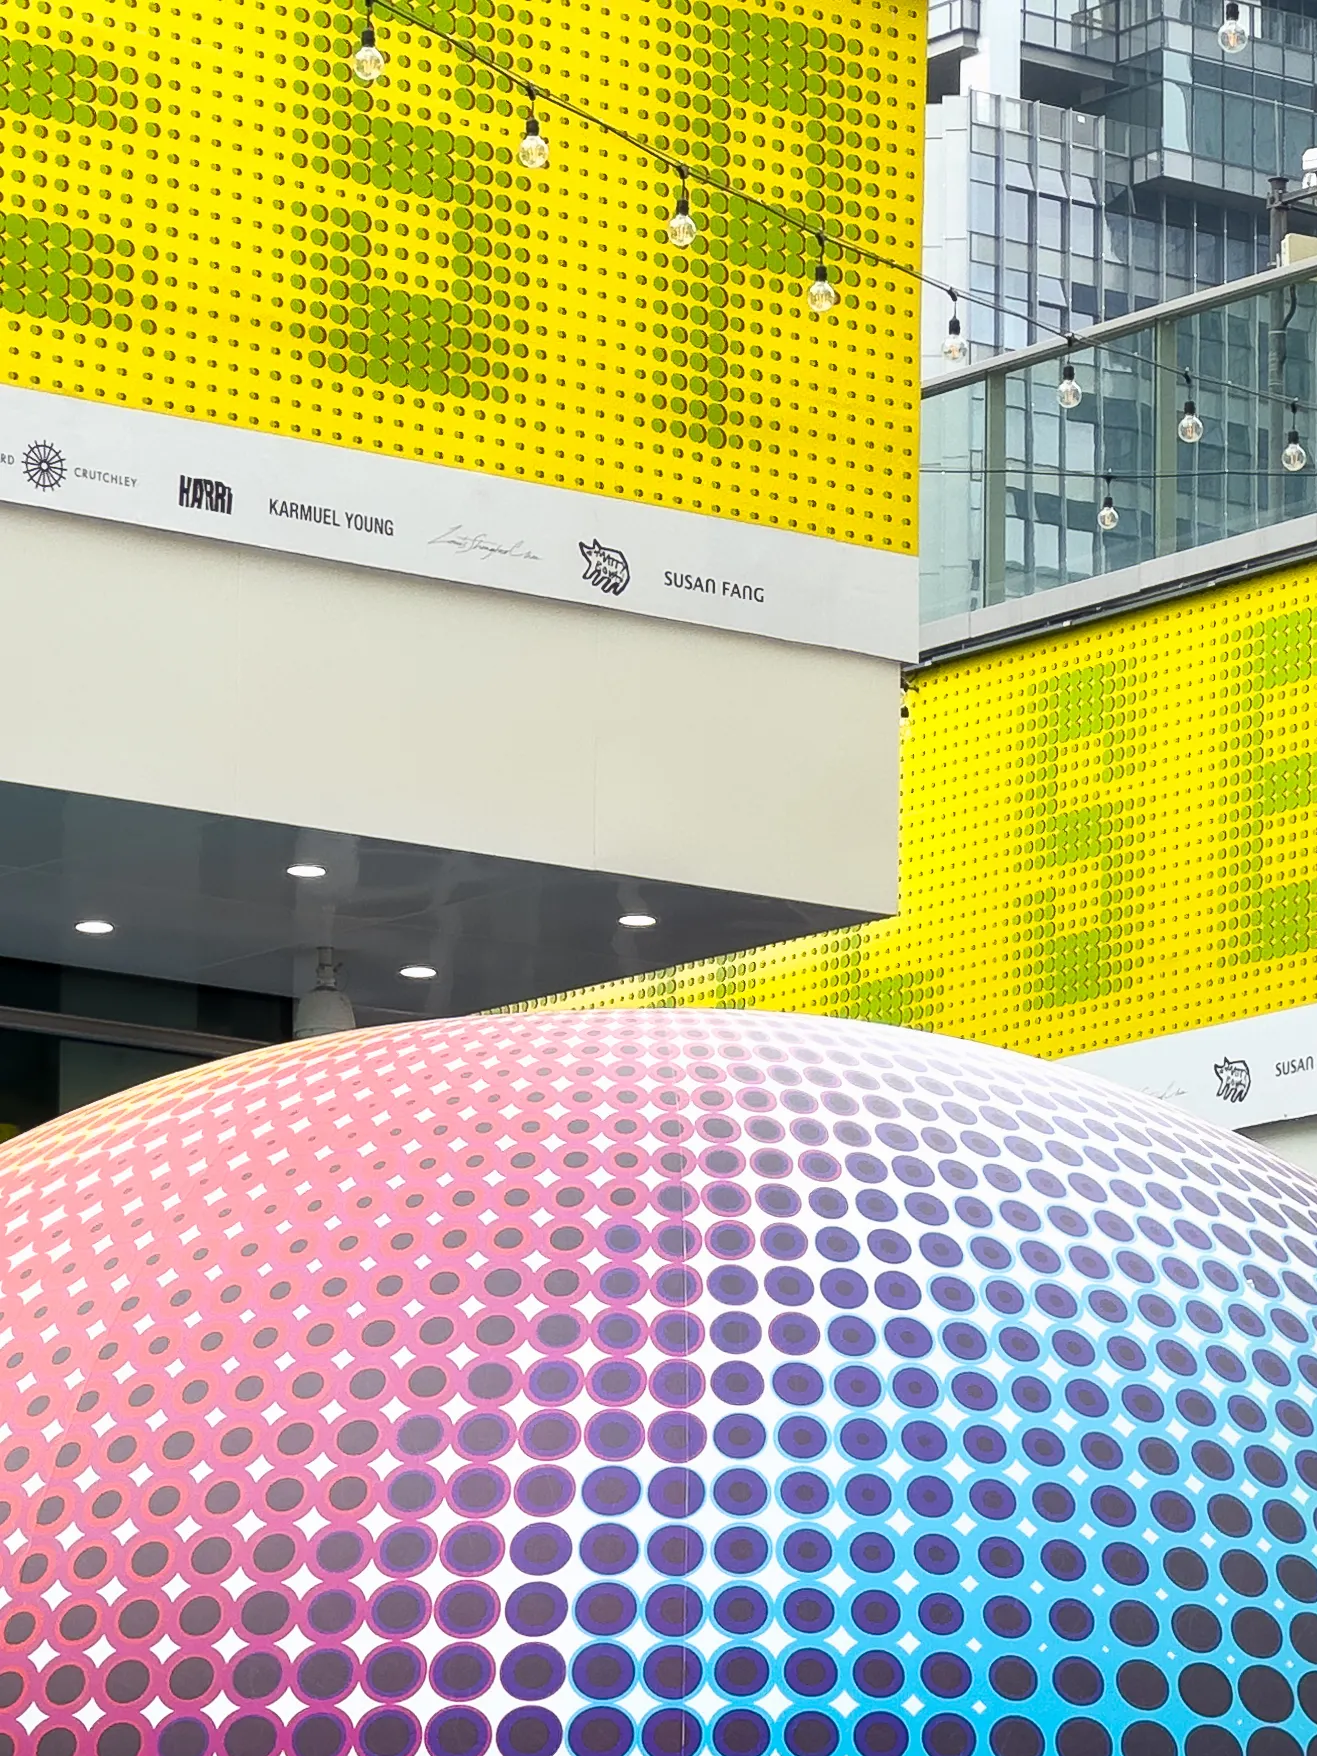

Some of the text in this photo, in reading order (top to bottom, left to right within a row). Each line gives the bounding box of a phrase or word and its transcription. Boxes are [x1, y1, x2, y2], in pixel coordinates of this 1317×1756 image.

[73, 467, 138, 488] CRUTCHLEY
[178, 474, 234, 516] HARRI
[268, 497, 394, 537] KARMUEL YOUNG
[664, 570, 765, 603] SUSAN FANG
[1274, 1055, 1314, 1078] SUSAN
